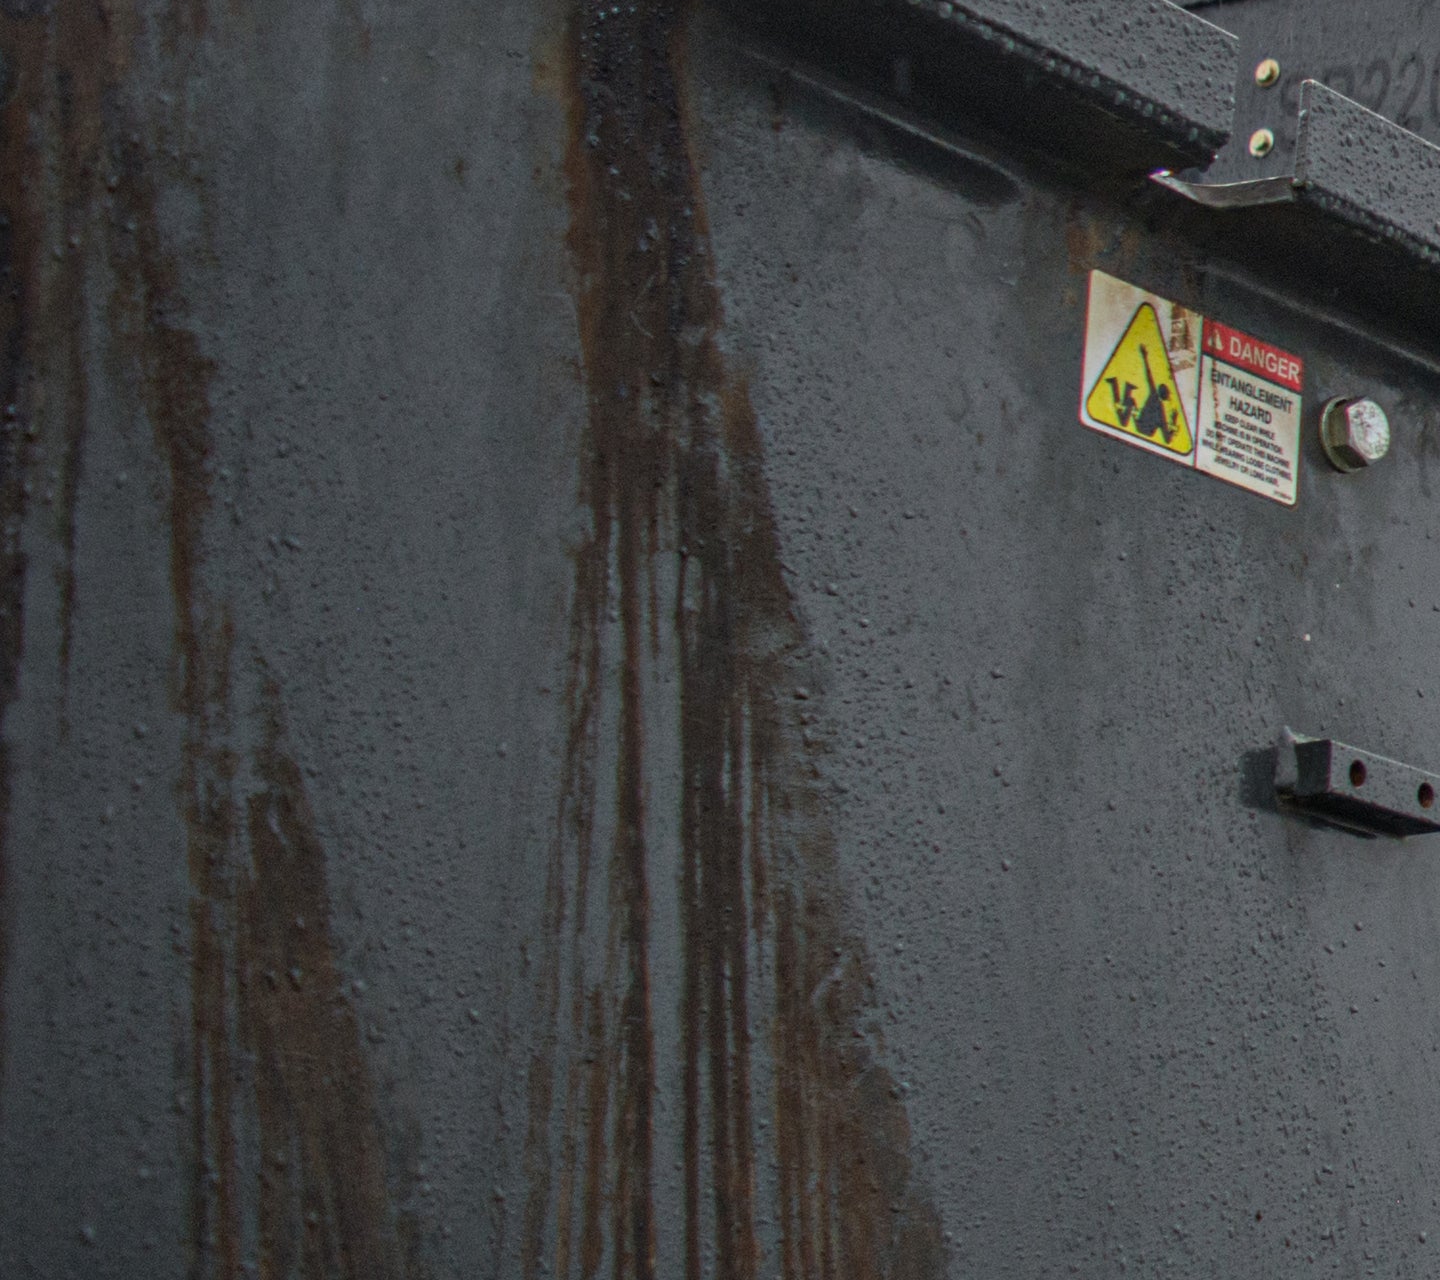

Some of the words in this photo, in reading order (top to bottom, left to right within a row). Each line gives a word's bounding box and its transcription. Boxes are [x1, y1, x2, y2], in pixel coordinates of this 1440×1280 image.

[1229, 335, 1300, 384] DANGER
[1211, 368, 1293, 415] ENTANGLEMENT
[1229, 396, 1272, 425] HAZARD
